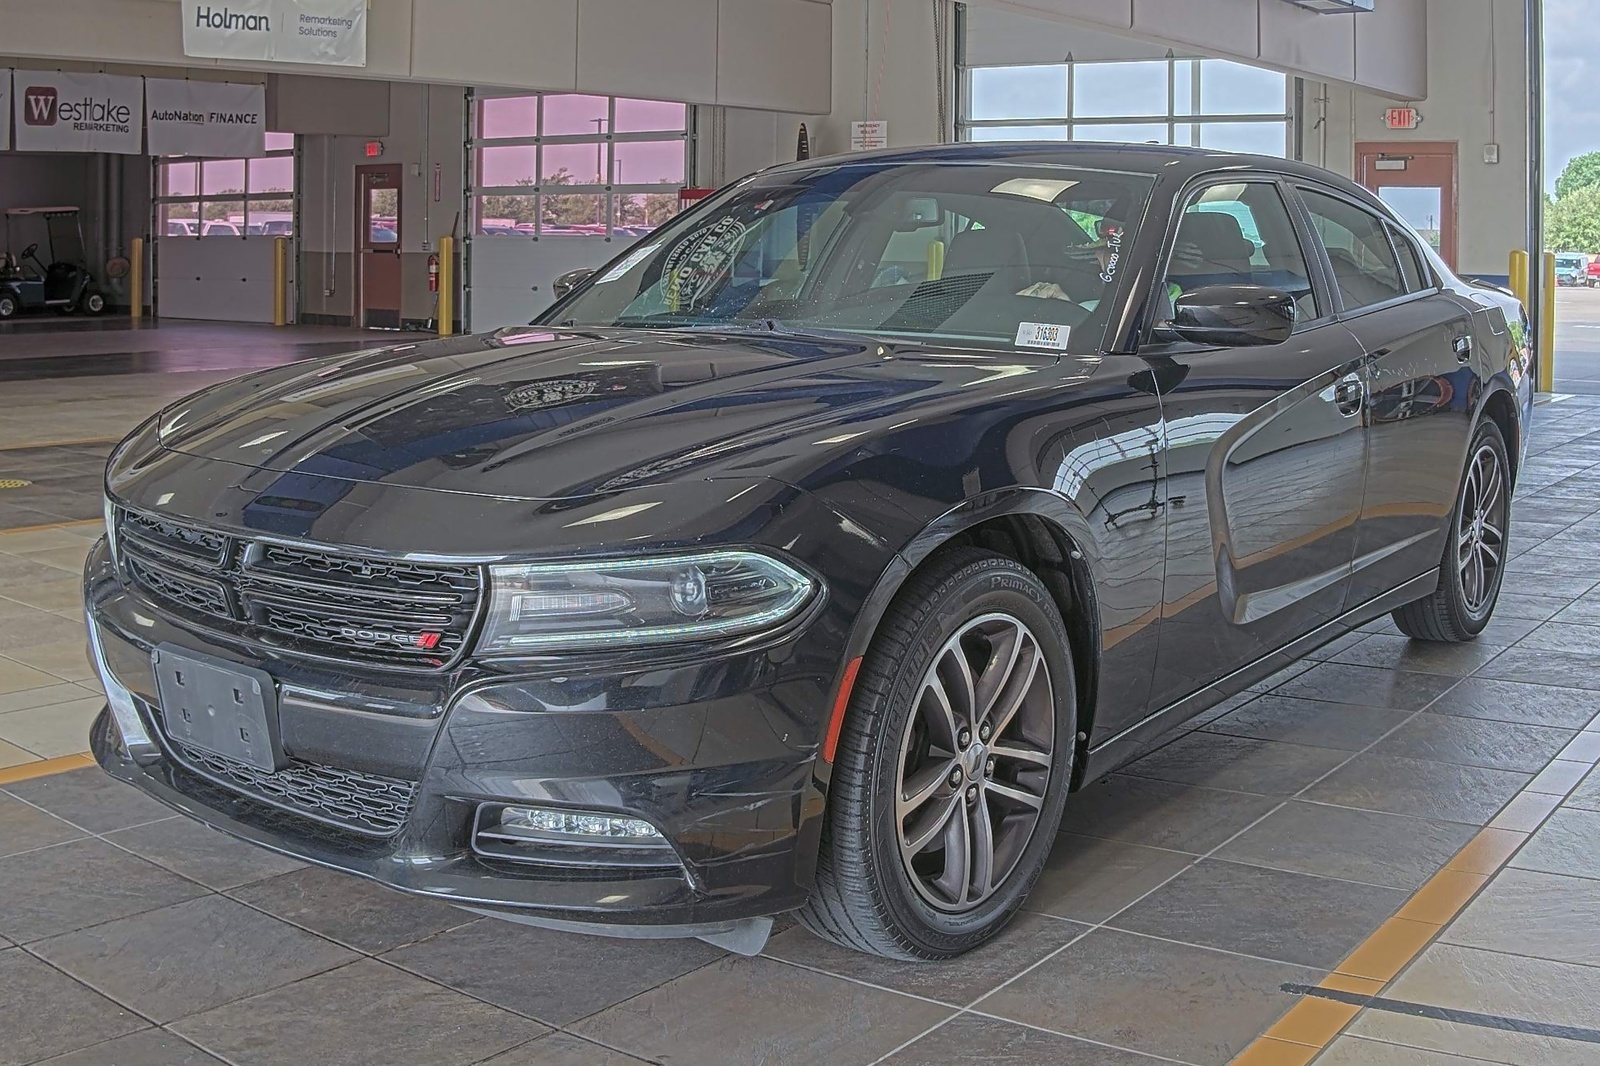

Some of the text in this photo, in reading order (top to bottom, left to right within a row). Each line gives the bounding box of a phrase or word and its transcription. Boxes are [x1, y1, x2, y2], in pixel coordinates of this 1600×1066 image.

[196, 6, 270, 31] Holman
[299, 13, 353, 29] Remarketing
[298, 26, 338, 38] Solutions
[27, 94, 131, 123] Westlake
[151, 109, 258, 124] AutoNation FINANCE
[1391, 109, 1411, 127] EXIT
[73, 122, 130, 133] REMARKETING
[341, 628, 425, 644] DODGE
